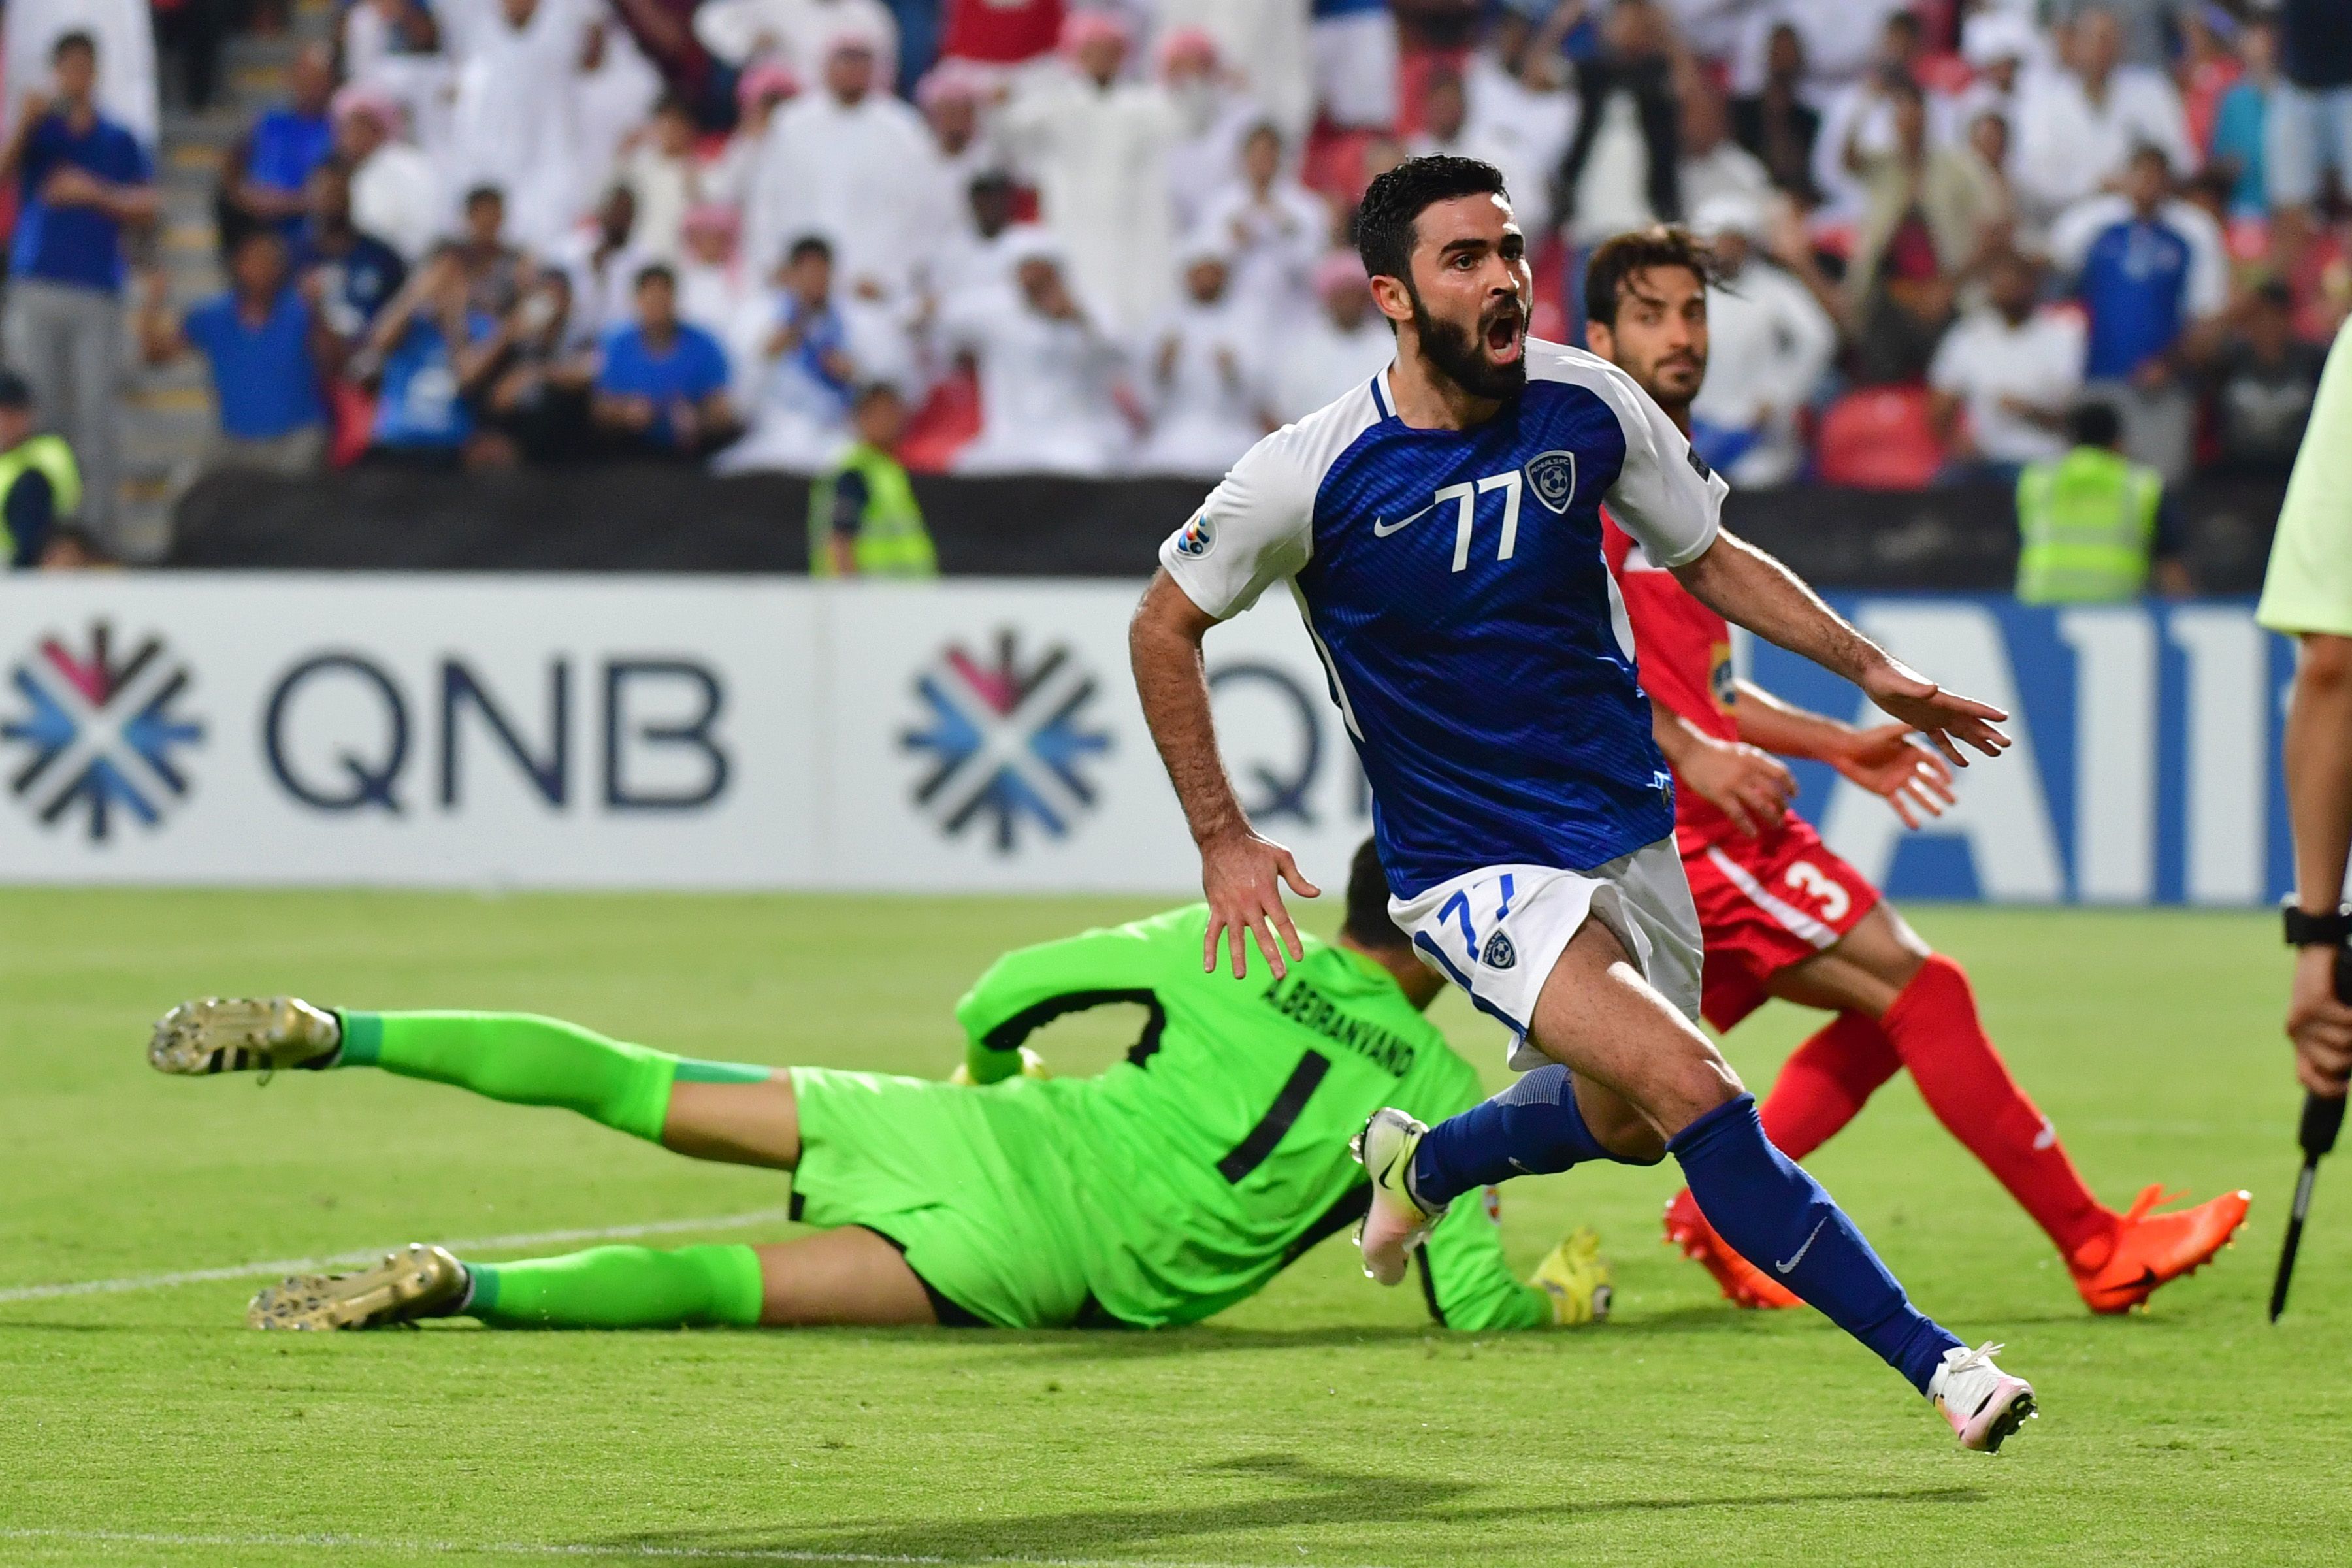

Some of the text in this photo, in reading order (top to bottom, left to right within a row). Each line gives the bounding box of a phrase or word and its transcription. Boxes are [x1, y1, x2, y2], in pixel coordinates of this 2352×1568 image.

[1435, 470, 1522, 573] 77
[261, 649, 736, 819] QNB
[1821, 600, 2295, 904] All
[1784, 861, 1850, 920] 3
[1217, 1049, 1331, 1185] 1
